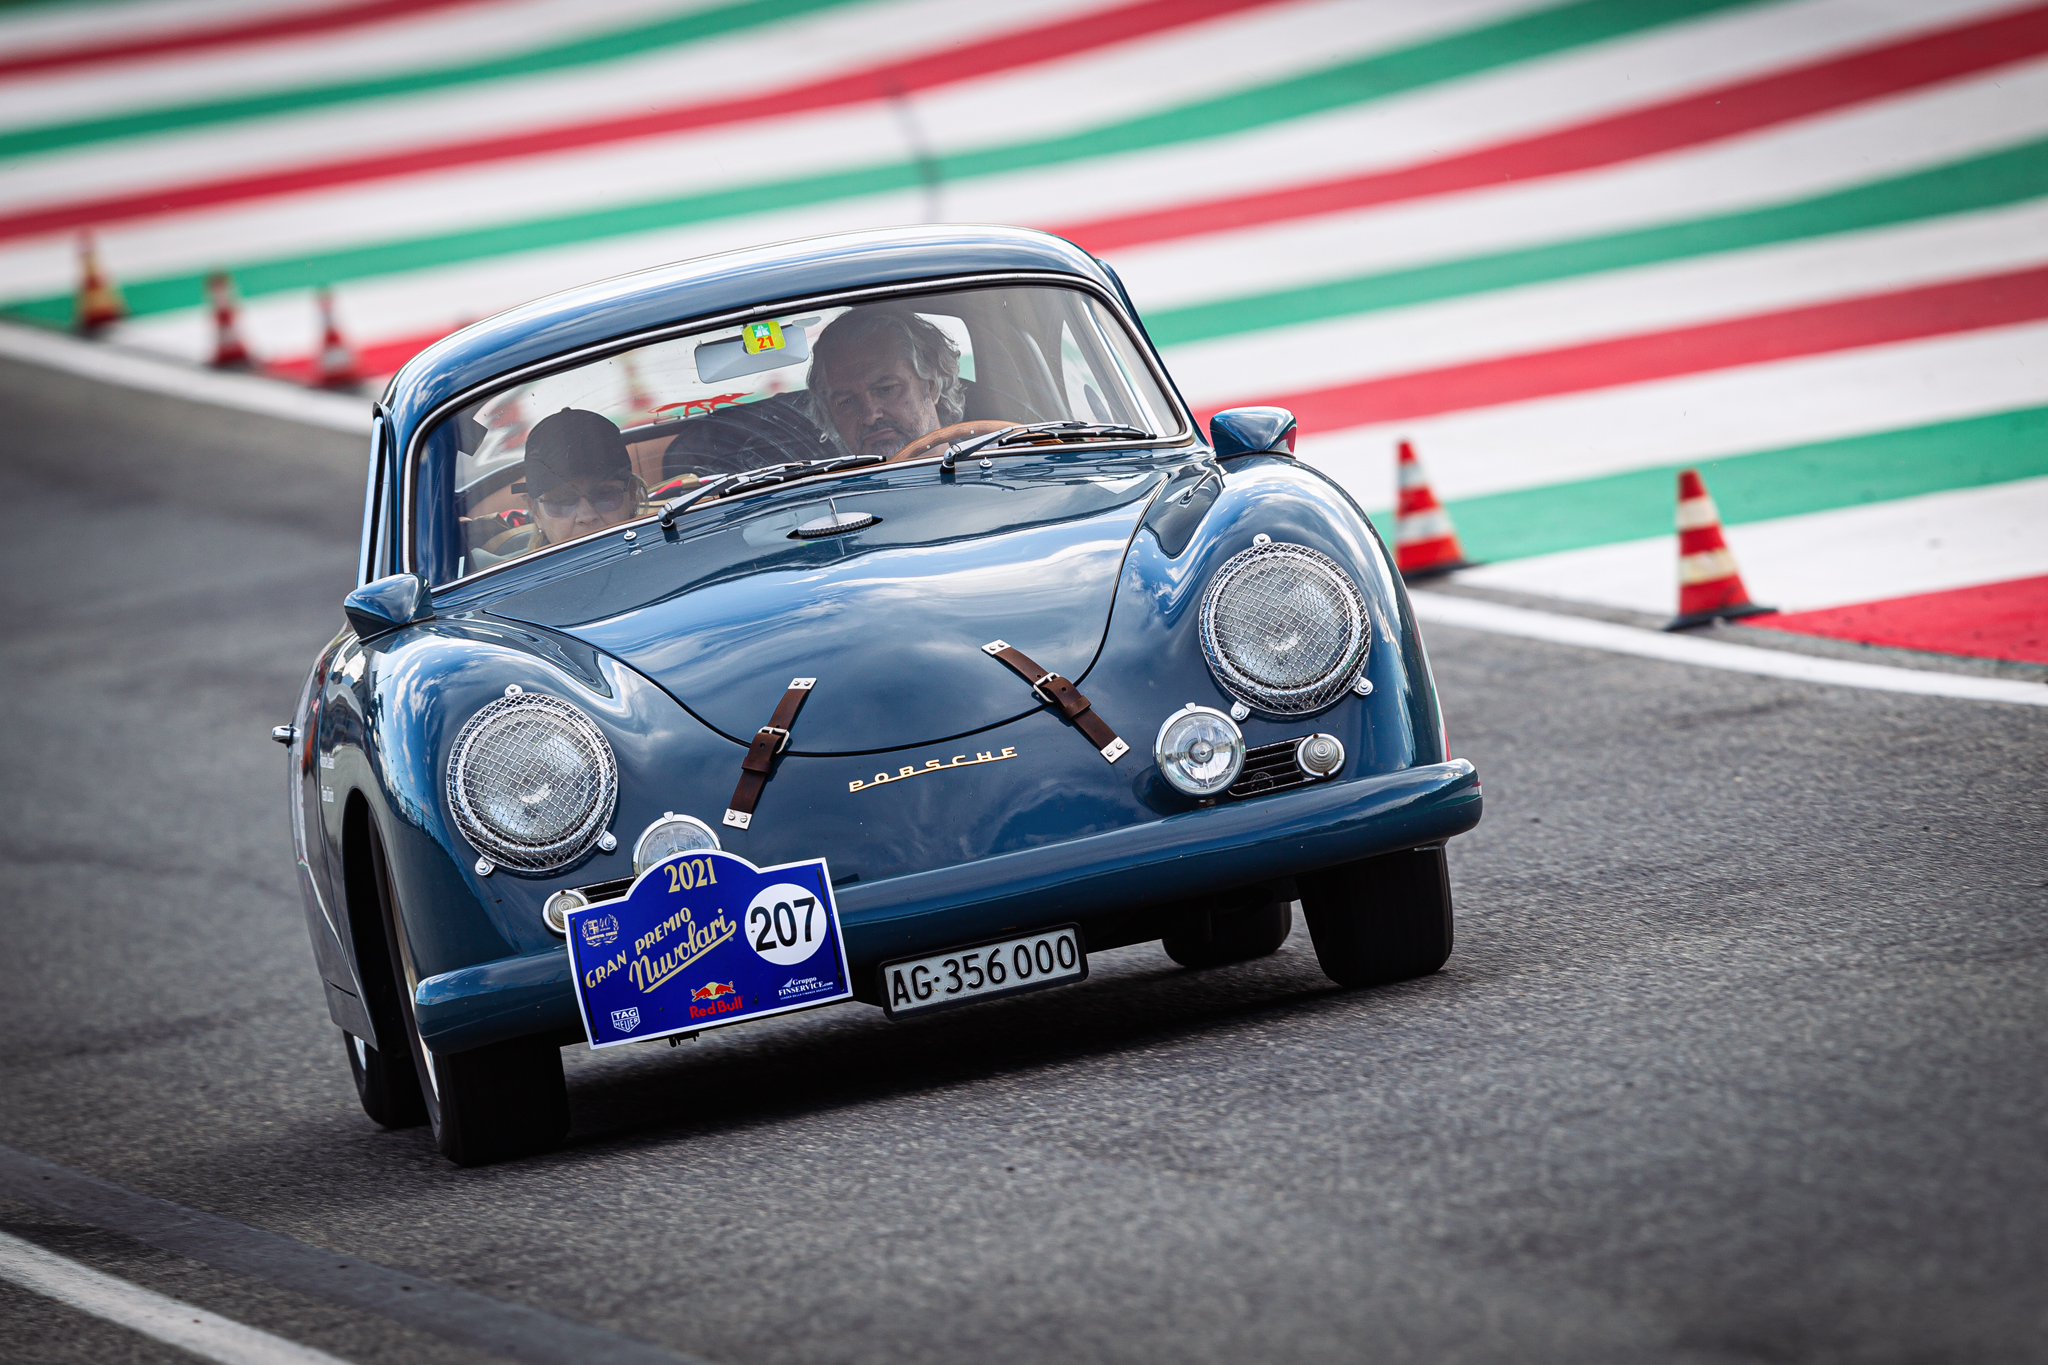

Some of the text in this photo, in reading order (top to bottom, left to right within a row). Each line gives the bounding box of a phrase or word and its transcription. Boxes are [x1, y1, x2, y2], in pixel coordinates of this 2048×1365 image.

[757, 335, 775, 350] 21
[848, 746, 1018, 793] PORSCHE
[664, 857, 718, 894] 2021
[750, 896, 816, 952] 207
[585, 907, 691, 989] GRAN PREMIO
[628, 908, 737, 993] Nuvolari
[792, 976, 817, 986] Gruppo
[614, 1009, 636, 1020] TAG
[689, 996, 743, 1019] Red Bull
[615, 1018, 640, 1031] HEUER
